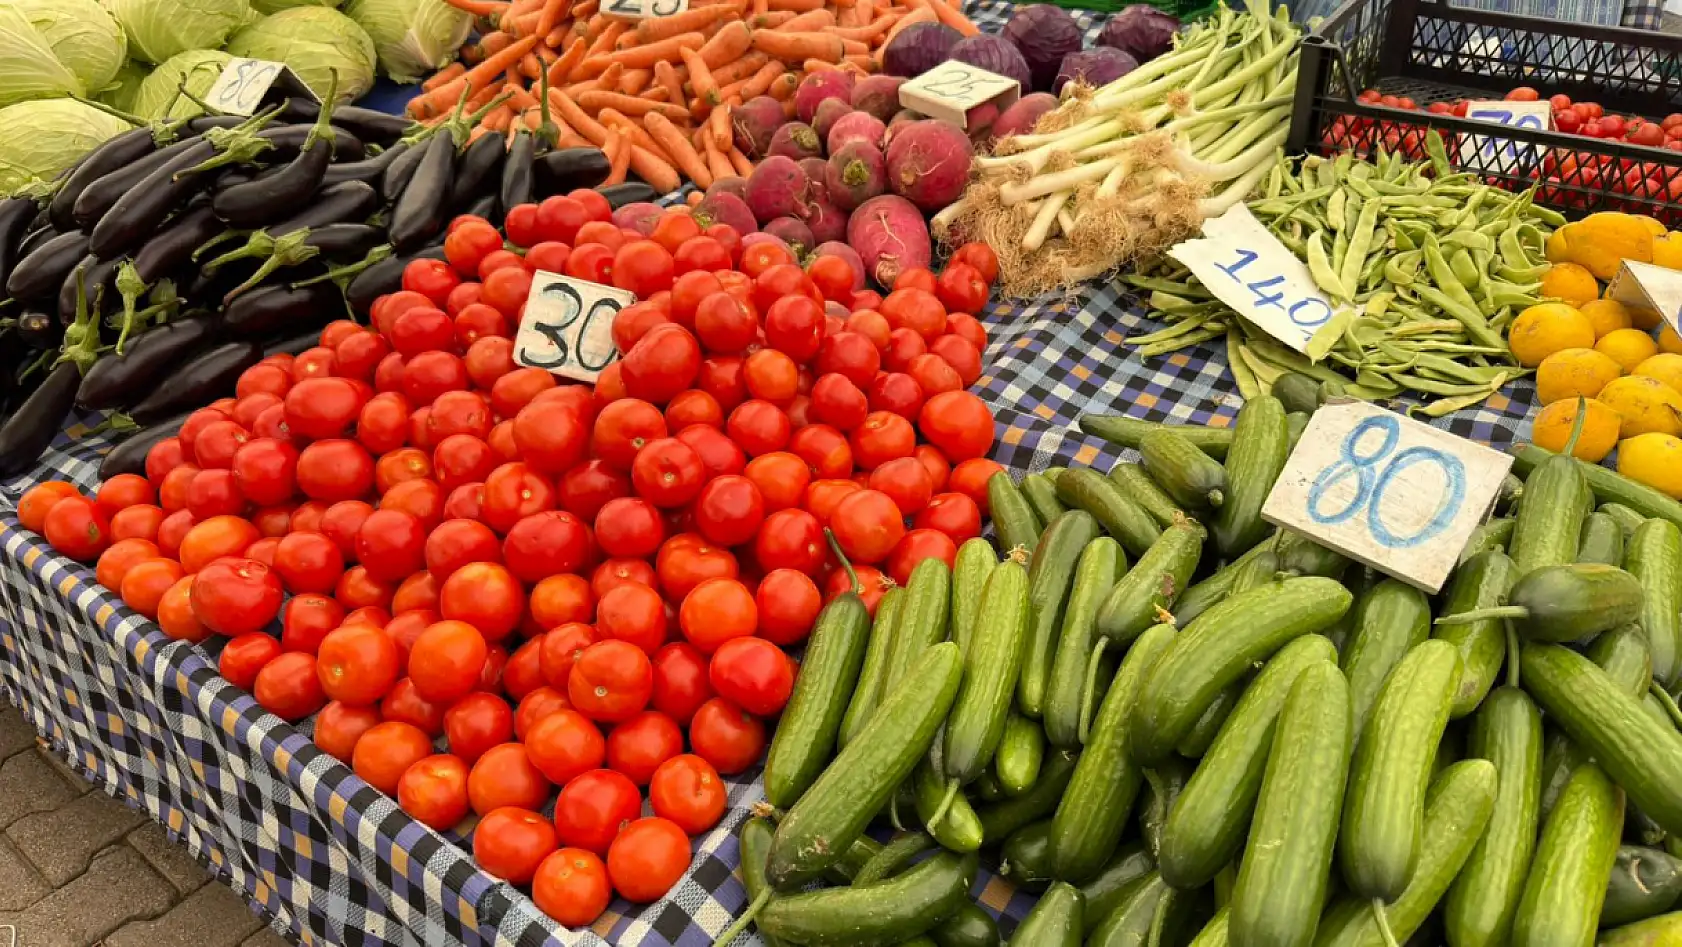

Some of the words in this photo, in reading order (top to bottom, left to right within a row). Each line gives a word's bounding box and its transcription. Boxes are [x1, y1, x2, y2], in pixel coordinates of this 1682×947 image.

[219, 60, 276, 109] 80
[520, 282, 622, 372] 30
[1214, 249, 1332, 326] 140
[1307, 415, 1467, 548] 80
